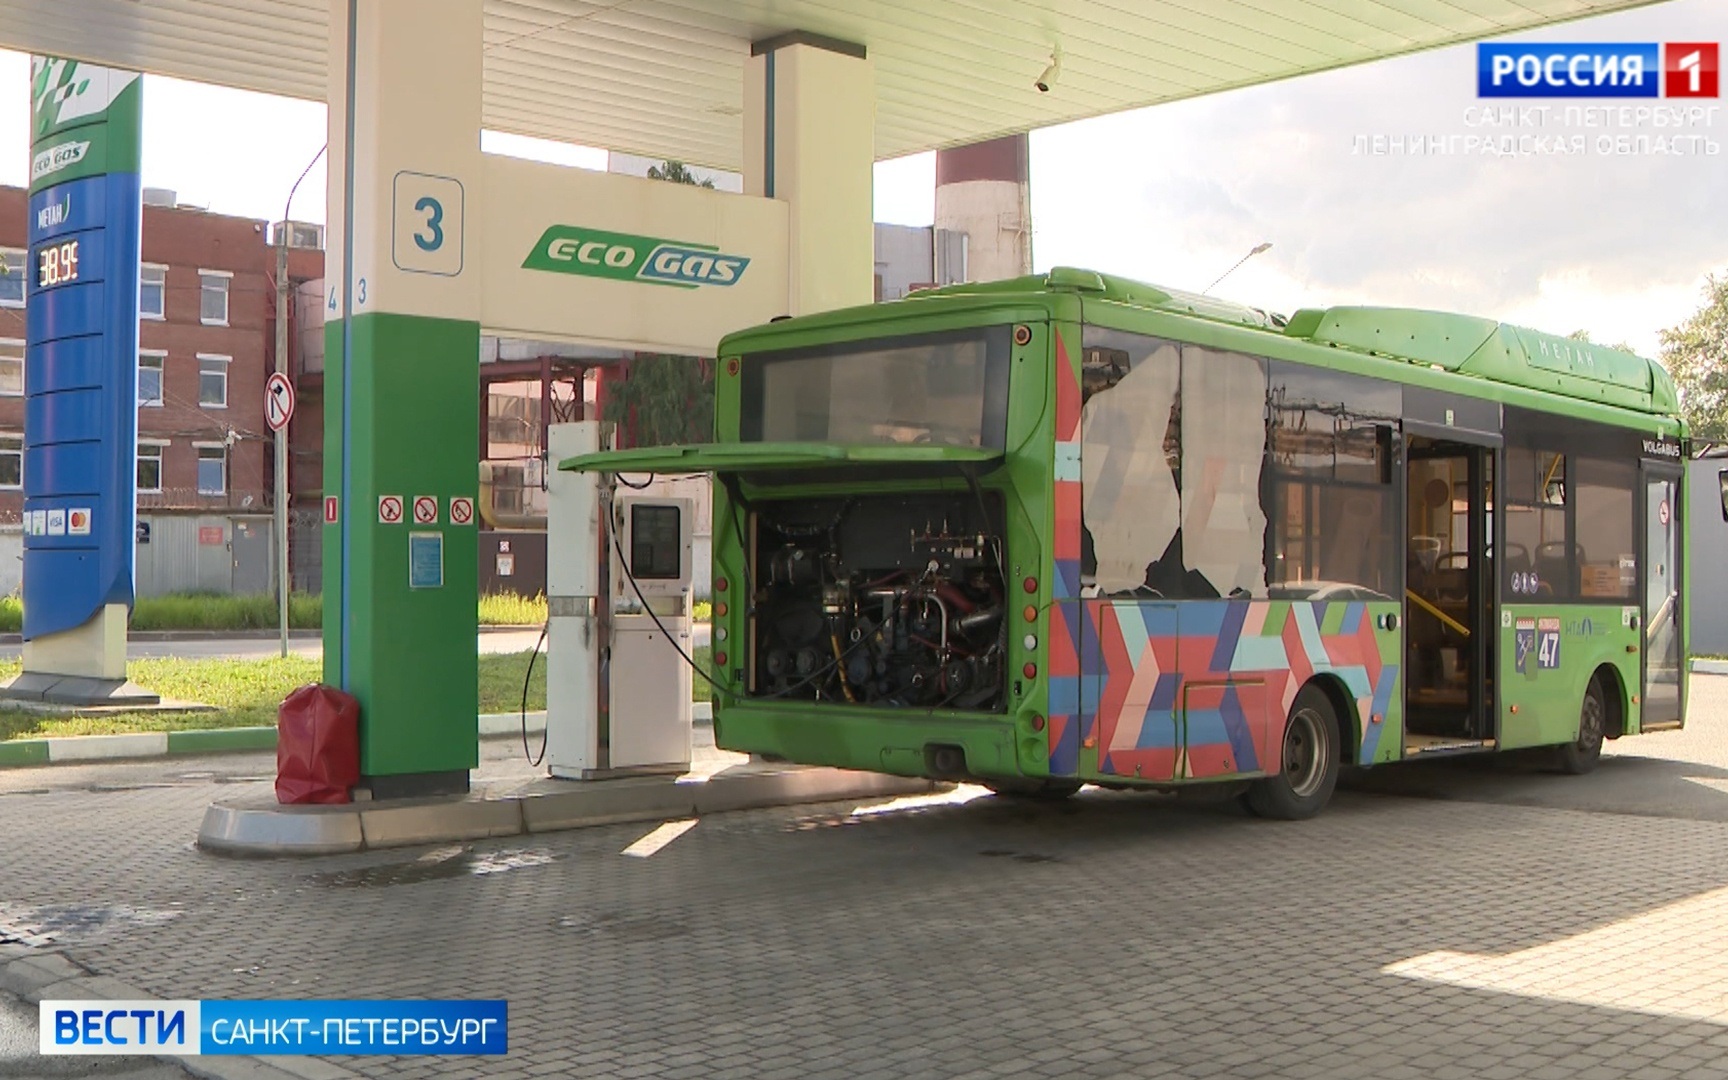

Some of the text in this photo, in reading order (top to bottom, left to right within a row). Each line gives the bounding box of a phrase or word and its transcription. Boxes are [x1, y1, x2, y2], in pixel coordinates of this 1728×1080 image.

[38, 204, 63, 229] МЕТАН
[413, 196, 444, 252] 3
[547, 238, 636, 268] ECO
[328, 285, 337, 311] 4
[358, 278, 367, 304] 3
[1539, 339, 1594, 367] МЕТАН
[1642, 439, 1680, 457] VOLGABUS
[1538, 632, 1559, 668] 47
